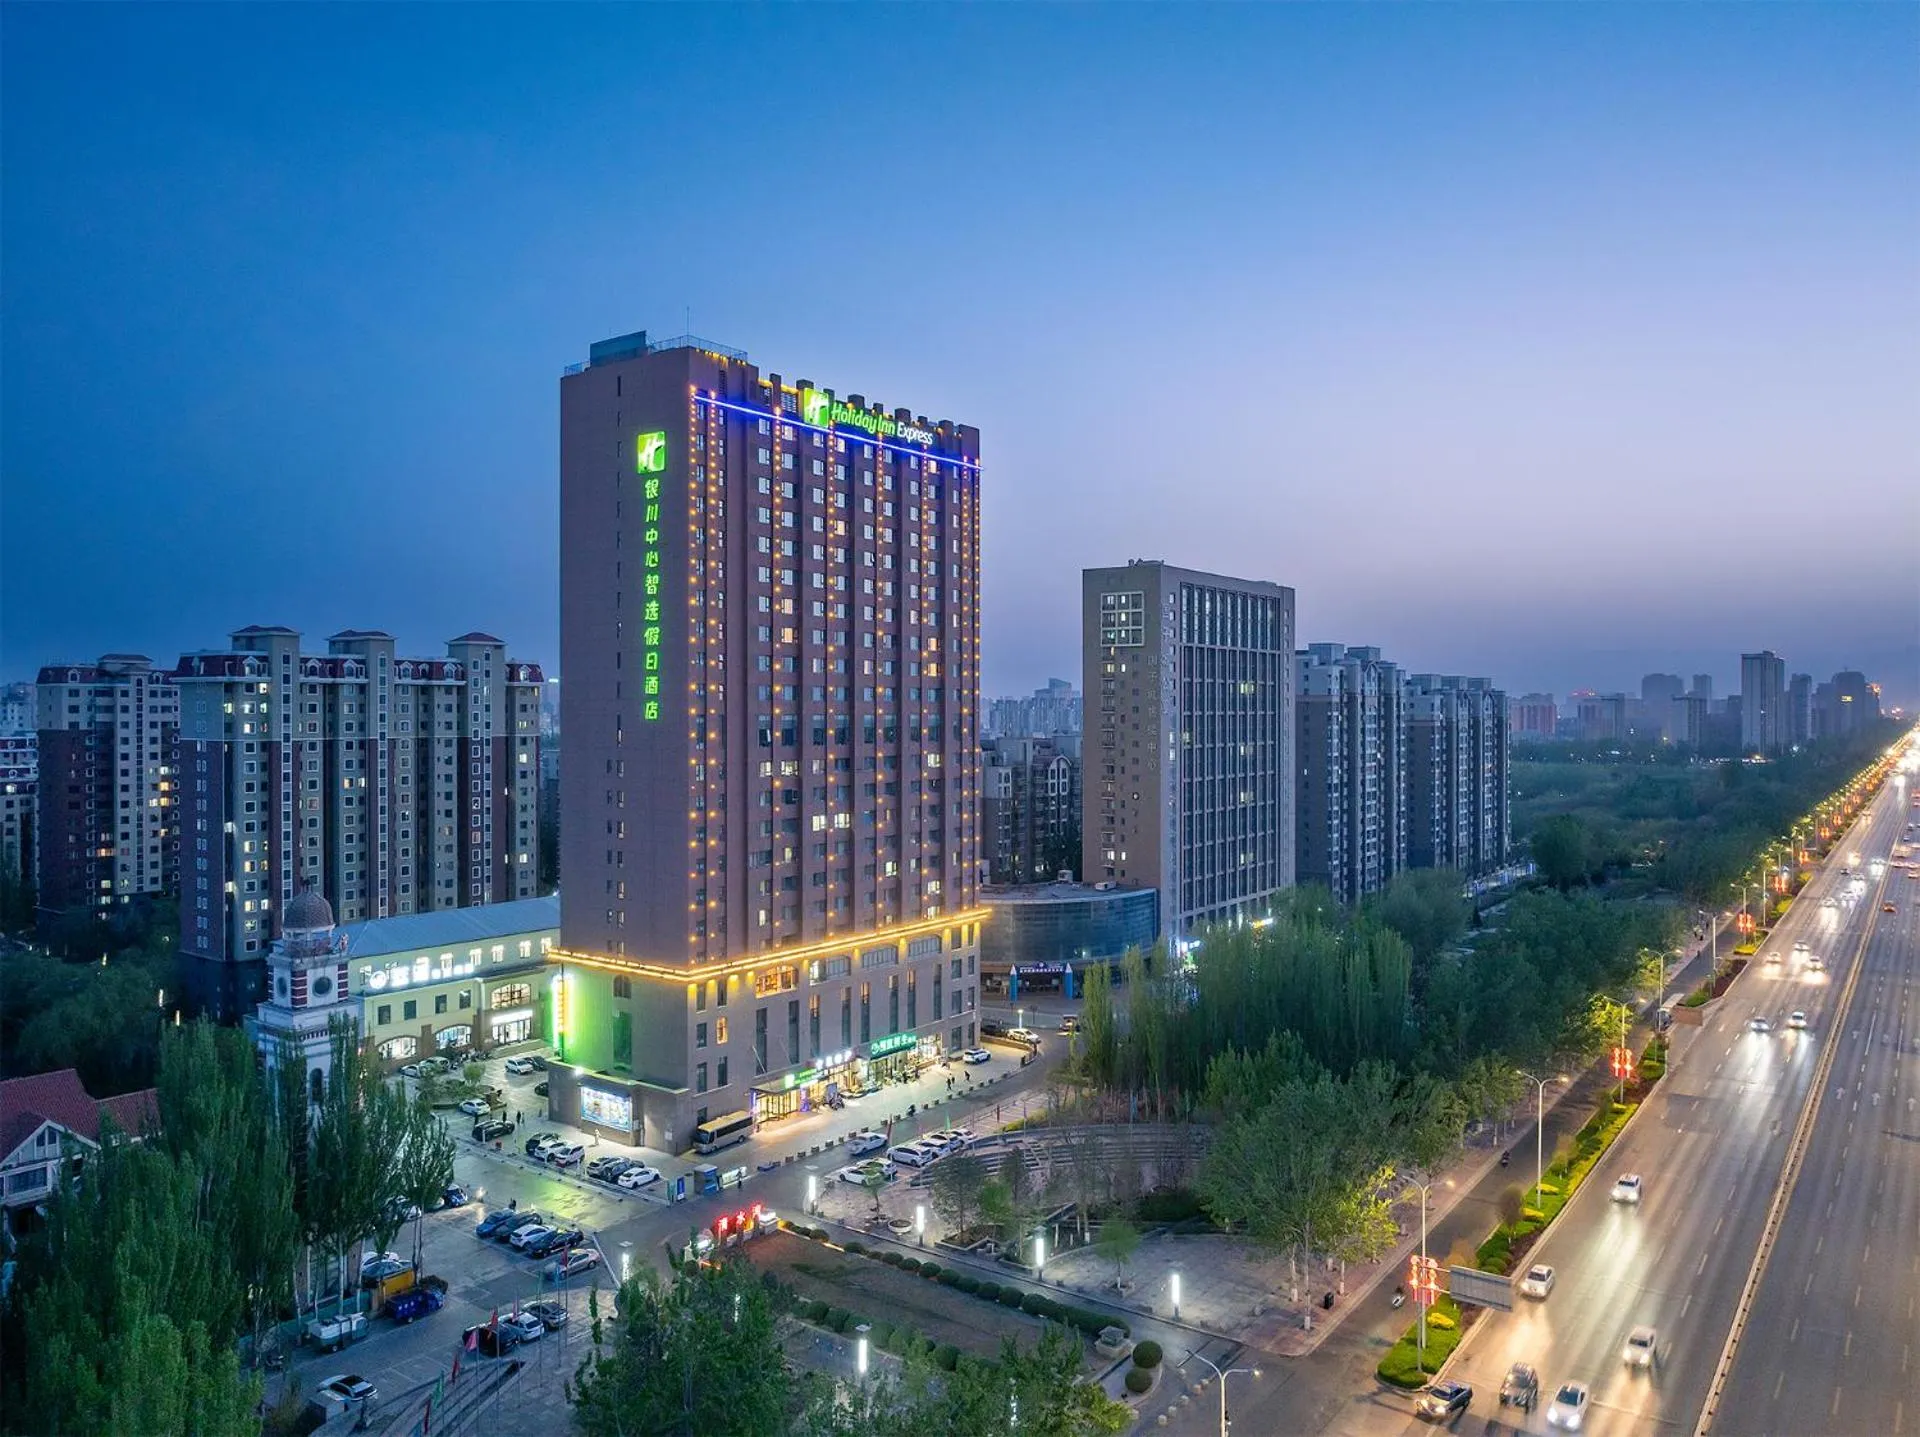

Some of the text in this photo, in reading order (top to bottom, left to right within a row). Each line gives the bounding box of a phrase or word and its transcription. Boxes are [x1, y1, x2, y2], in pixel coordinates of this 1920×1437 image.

[831, 402, 934, 445] Holiday Inn Express
[643, 478, 660, 721] 银川中心智选假日酒店
